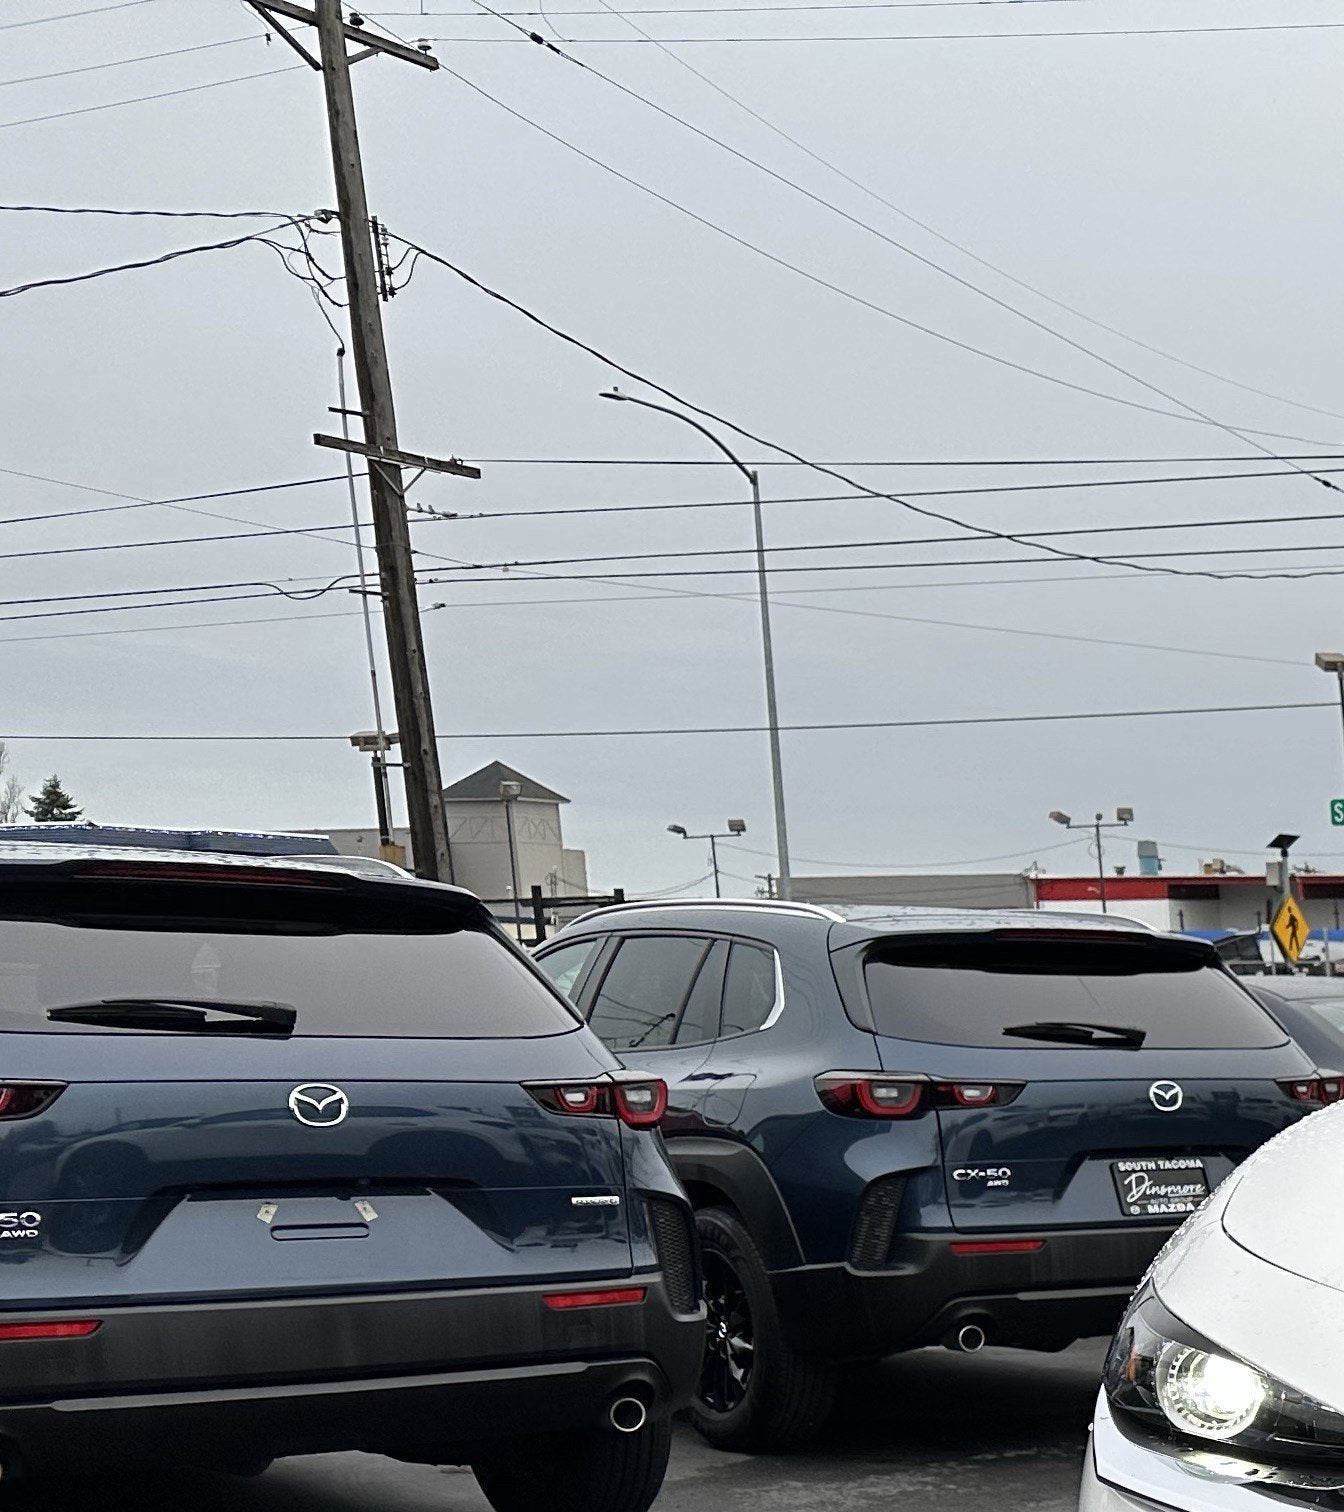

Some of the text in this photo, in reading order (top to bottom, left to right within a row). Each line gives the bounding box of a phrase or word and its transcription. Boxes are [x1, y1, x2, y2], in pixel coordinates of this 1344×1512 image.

[1118, 1159, 1203, 1172] SOUTH TACOMA
[953, 1167, 1011, 1180] CX-50
[1124, 1172, 1205, 1203] Dinsmore
[1147, 1203, 1195, 1213] MAZDA
[0, 1230, 38, 1238] AWD
